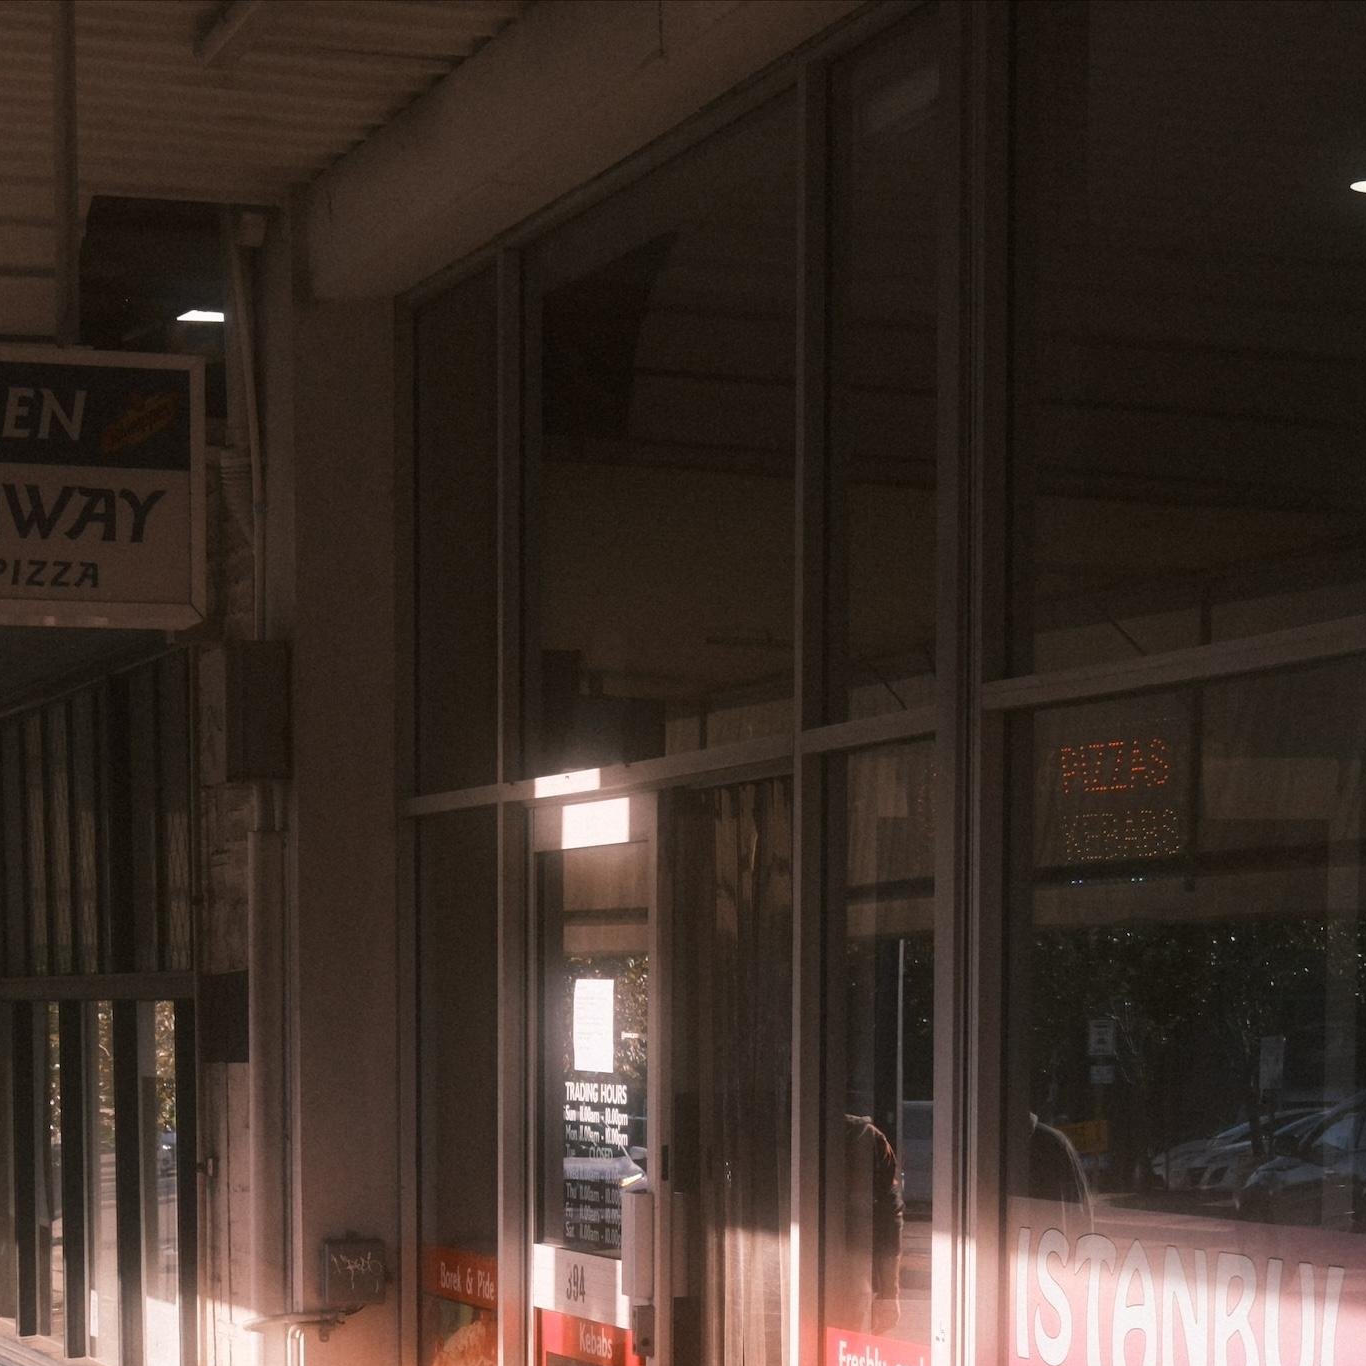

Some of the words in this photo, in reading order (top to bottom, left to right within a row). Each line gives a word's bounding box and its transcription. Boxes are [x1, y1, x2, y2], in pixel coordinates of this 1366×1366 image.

[1060, 738, 1169, 796] PIZZAS
[1063, 807, 1180, 861] KEBABS
[564, 1082, 599, 1104] TRADING
[600, 1083, 628, 1105] HOURS
[564, 1104, 576, 1121] Sun
[566, 1263, 586, 1304] 394
[579, 1322, 613, 1360] Kebabs
